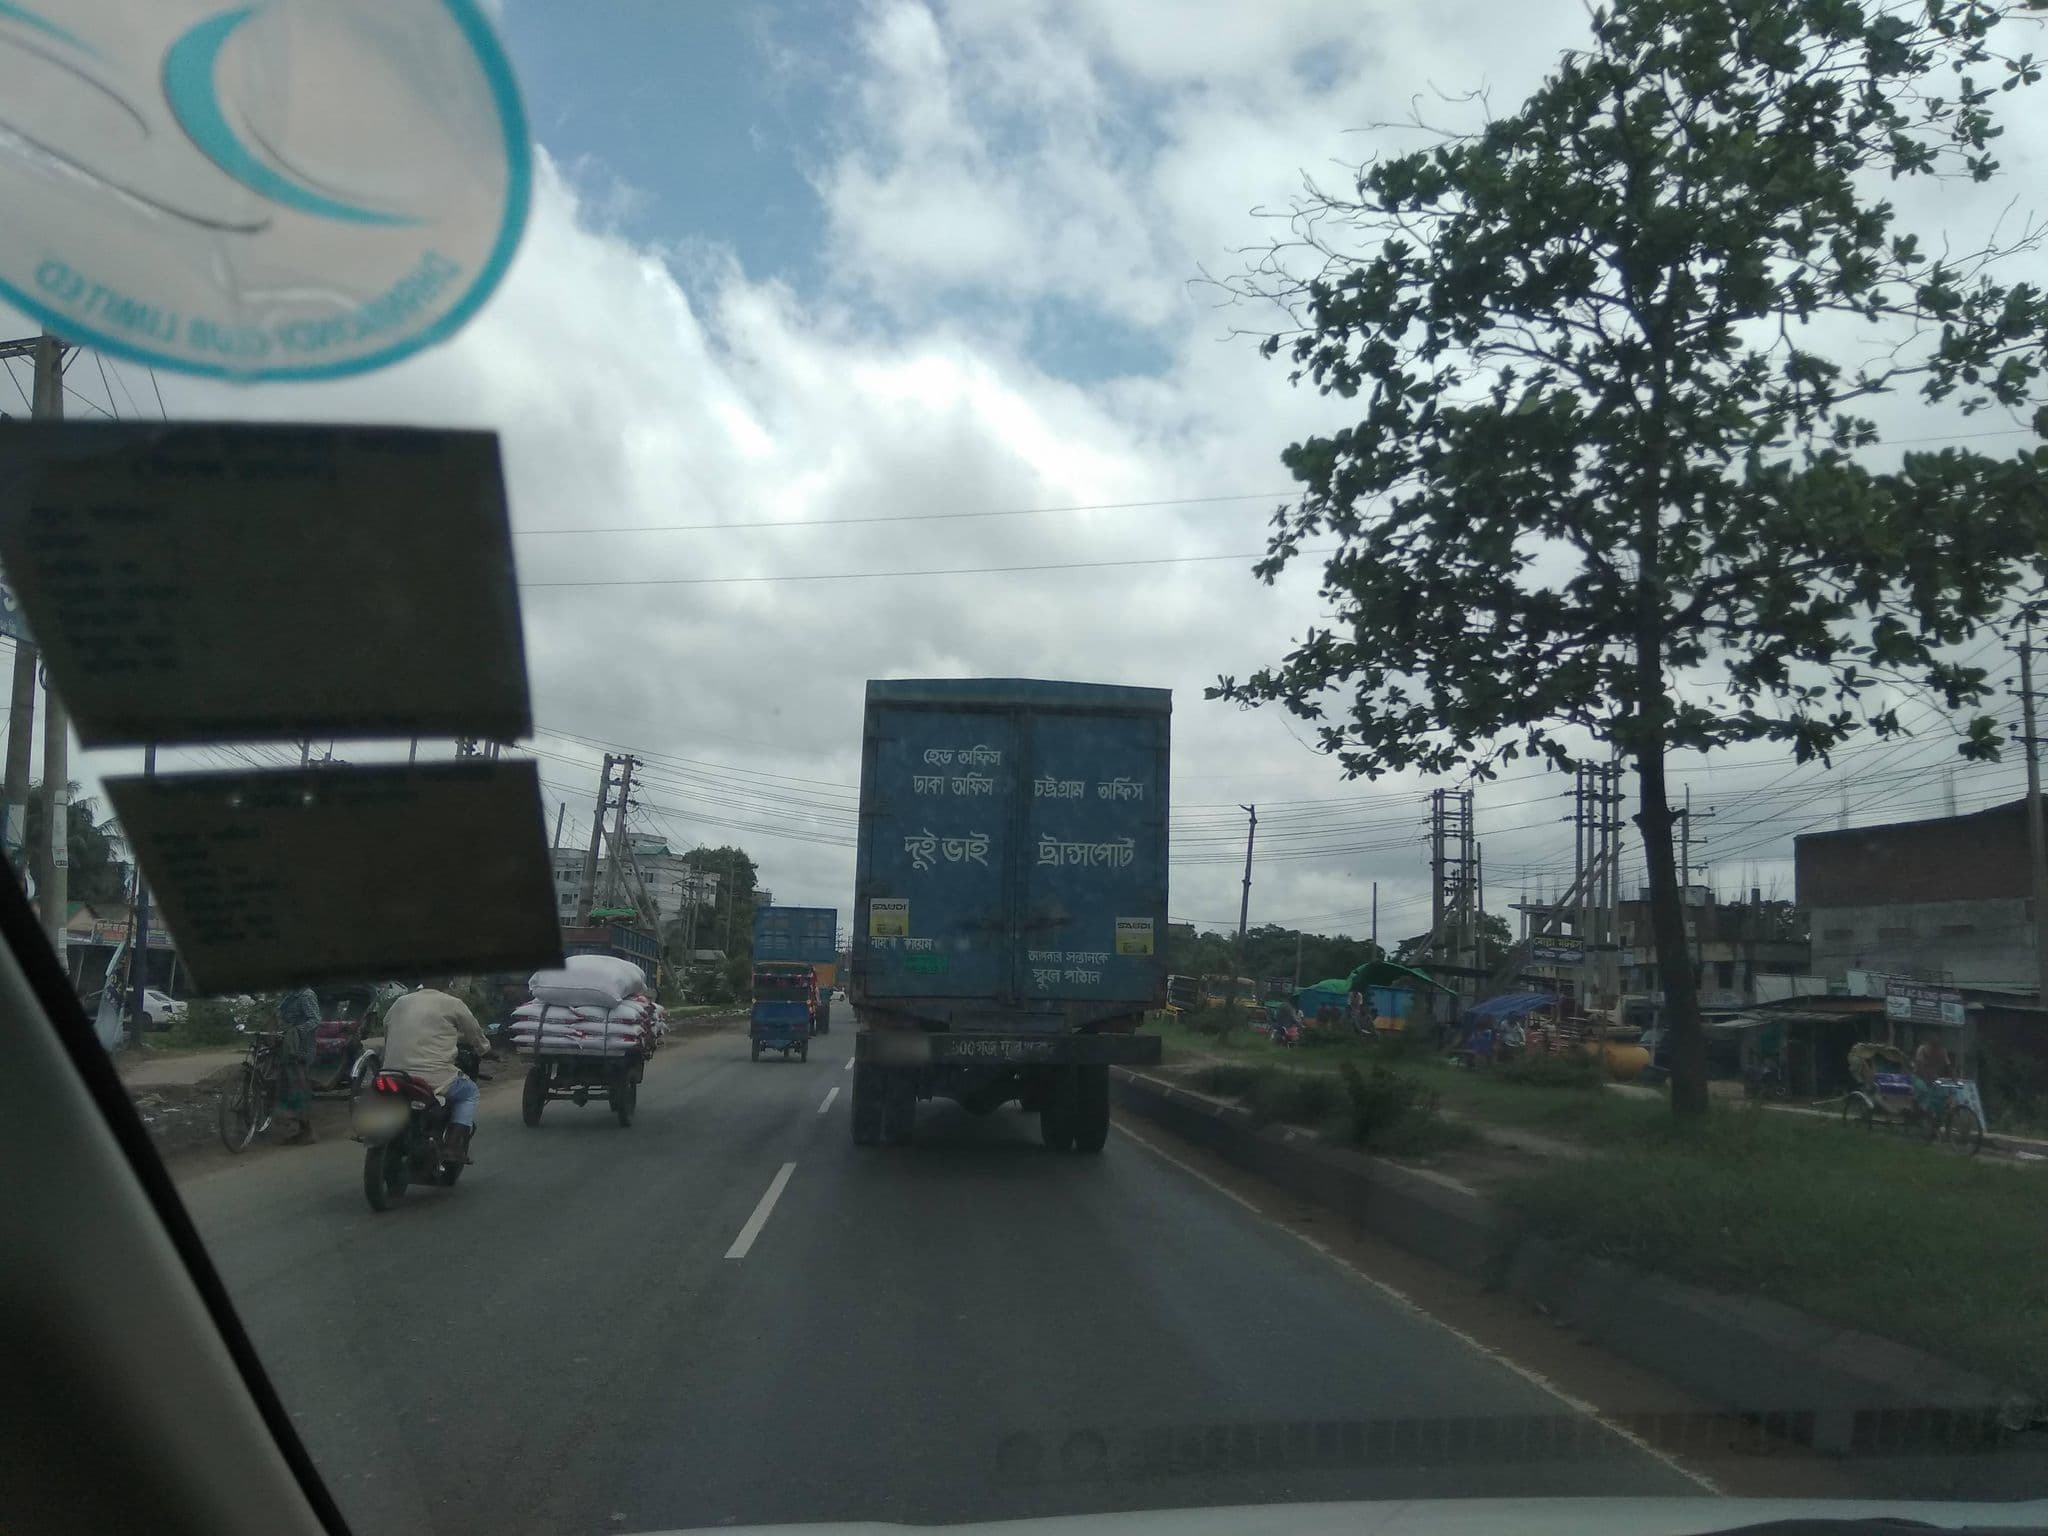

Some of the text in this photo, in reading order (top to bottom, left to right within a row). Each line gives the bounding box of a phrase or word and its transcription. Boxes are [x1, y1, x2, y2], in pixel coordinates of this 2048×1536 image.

[923, 743, 1001, 767] হেড অফিস
[912, 771, 994, 796] ঢাকা অফিস
[1096, 776, 1144, 801] অফিস
[903, 826, 990, 871] দুই ভাই
[871, 903, 906, 911] SAUDI
[1117, 922, 1152, 930] SAUDI
[1028, 950, 1110, 965] আপনার সন্তানকে
[1032, 966, 1103, 990] স্কুলে পাঠান
